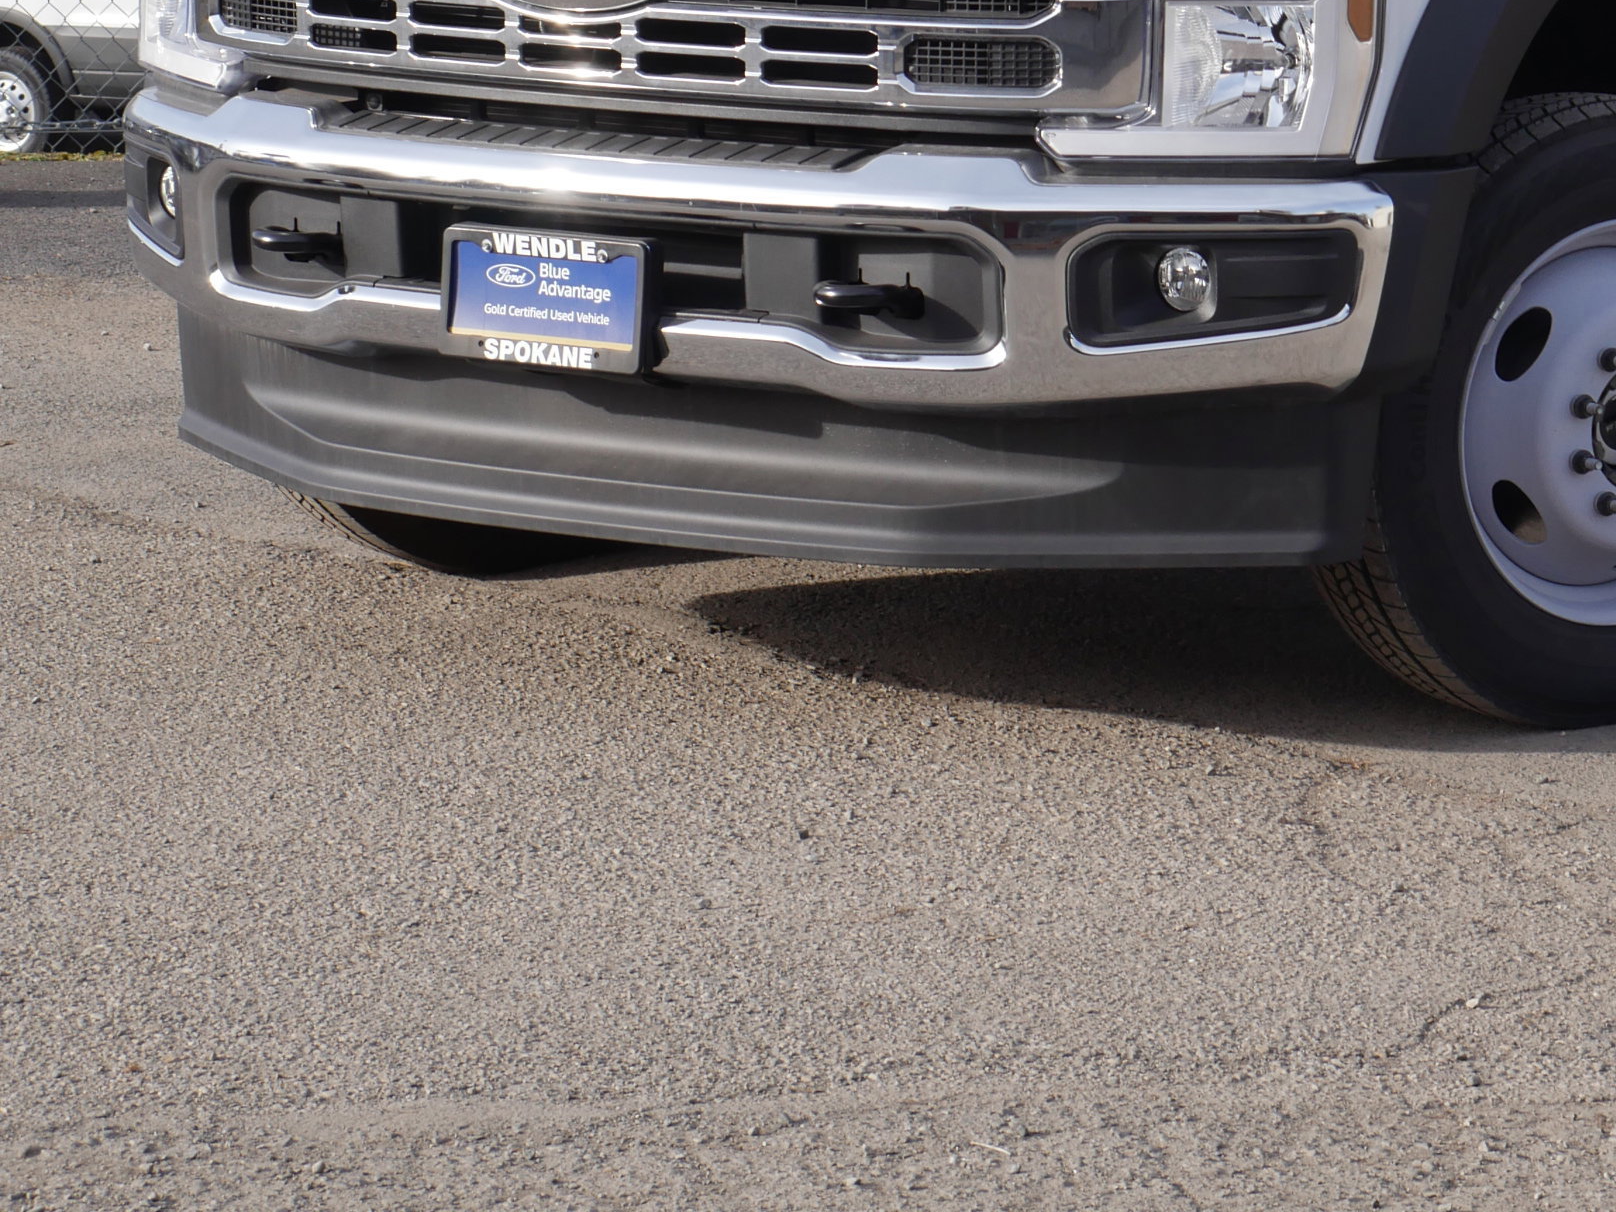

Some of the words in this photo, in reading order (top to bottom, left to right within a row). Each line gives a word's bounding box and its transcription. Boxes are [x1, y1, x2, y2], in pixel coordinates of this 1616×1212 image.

[492, 232, 597, 263] WENDLE
[494, 265, 526, 285] Ford
[539, 262, 570, 280] Blue
[538, 280, 611, 303] Advantage
[484, 302, 507, 316] Gold
[508, 305, 548, 320] Certified
[550, 309, 575, 323] Used
[577, 312, 610, 326] Vehicle
[484, 338, 593, 369] SPOKANE
